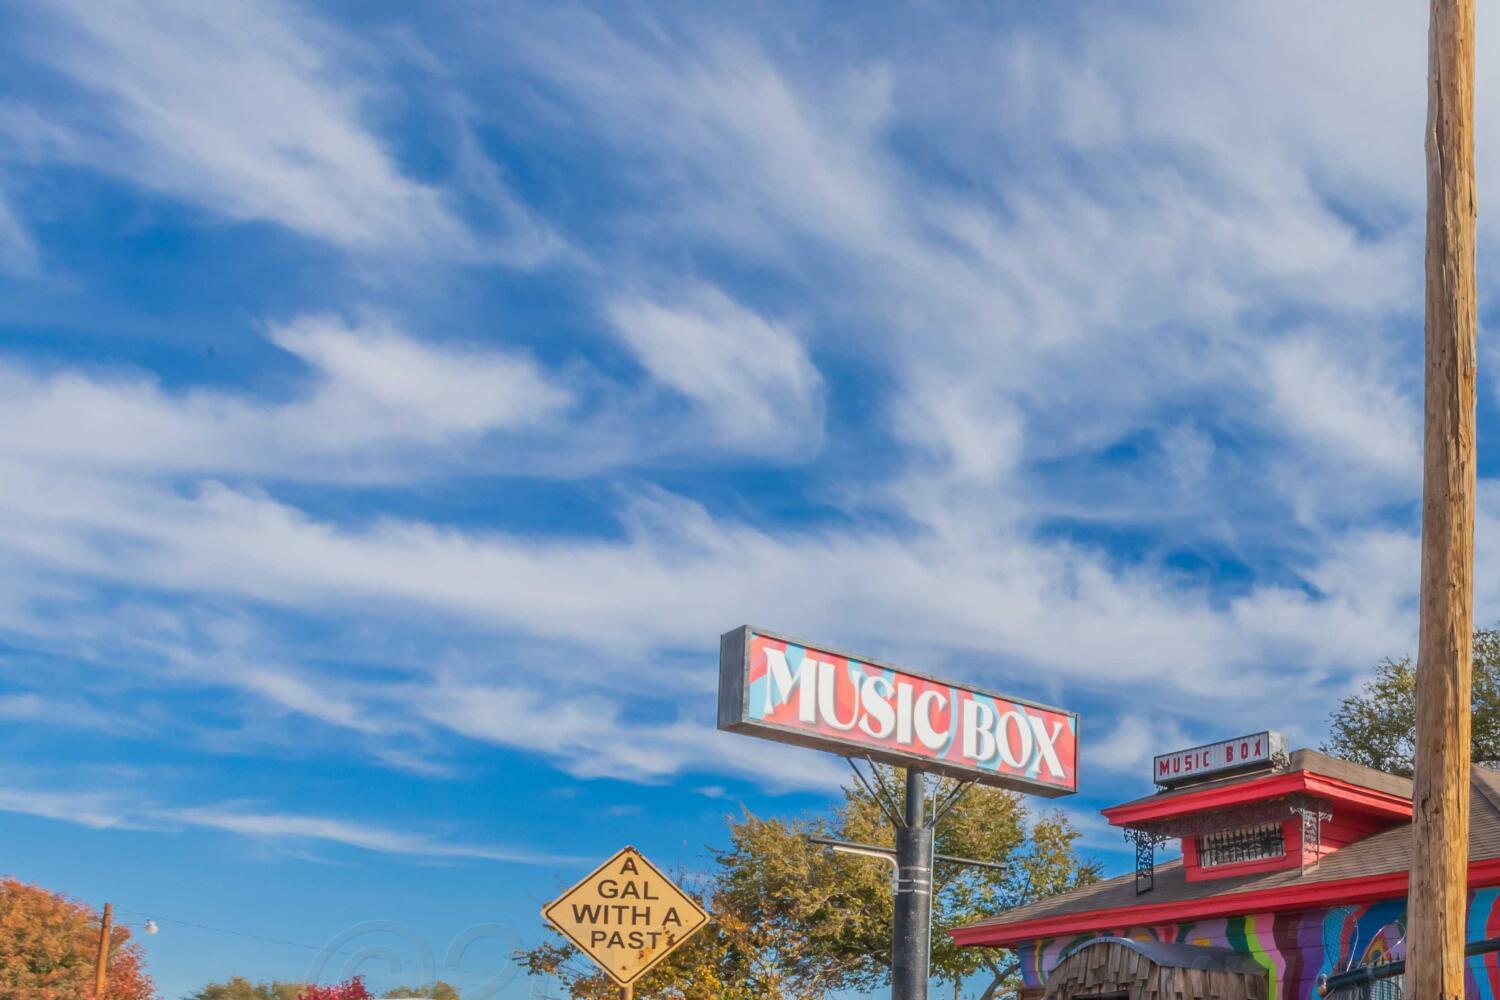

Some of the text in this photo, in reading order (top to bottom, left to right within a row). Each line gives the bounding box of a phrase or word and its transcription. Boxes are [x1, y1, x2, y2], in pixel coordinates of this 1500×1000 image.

[762, 646, 1066, 778] MUSIC BOX
[1159, 739, 1262, 776] MUSIC BOX
[619, 856, 639, 876] A
[597, 879, 659, 900] GAL
[572, 903, 682, 927] WITH A
[590, 930, 662, 950] PAST
